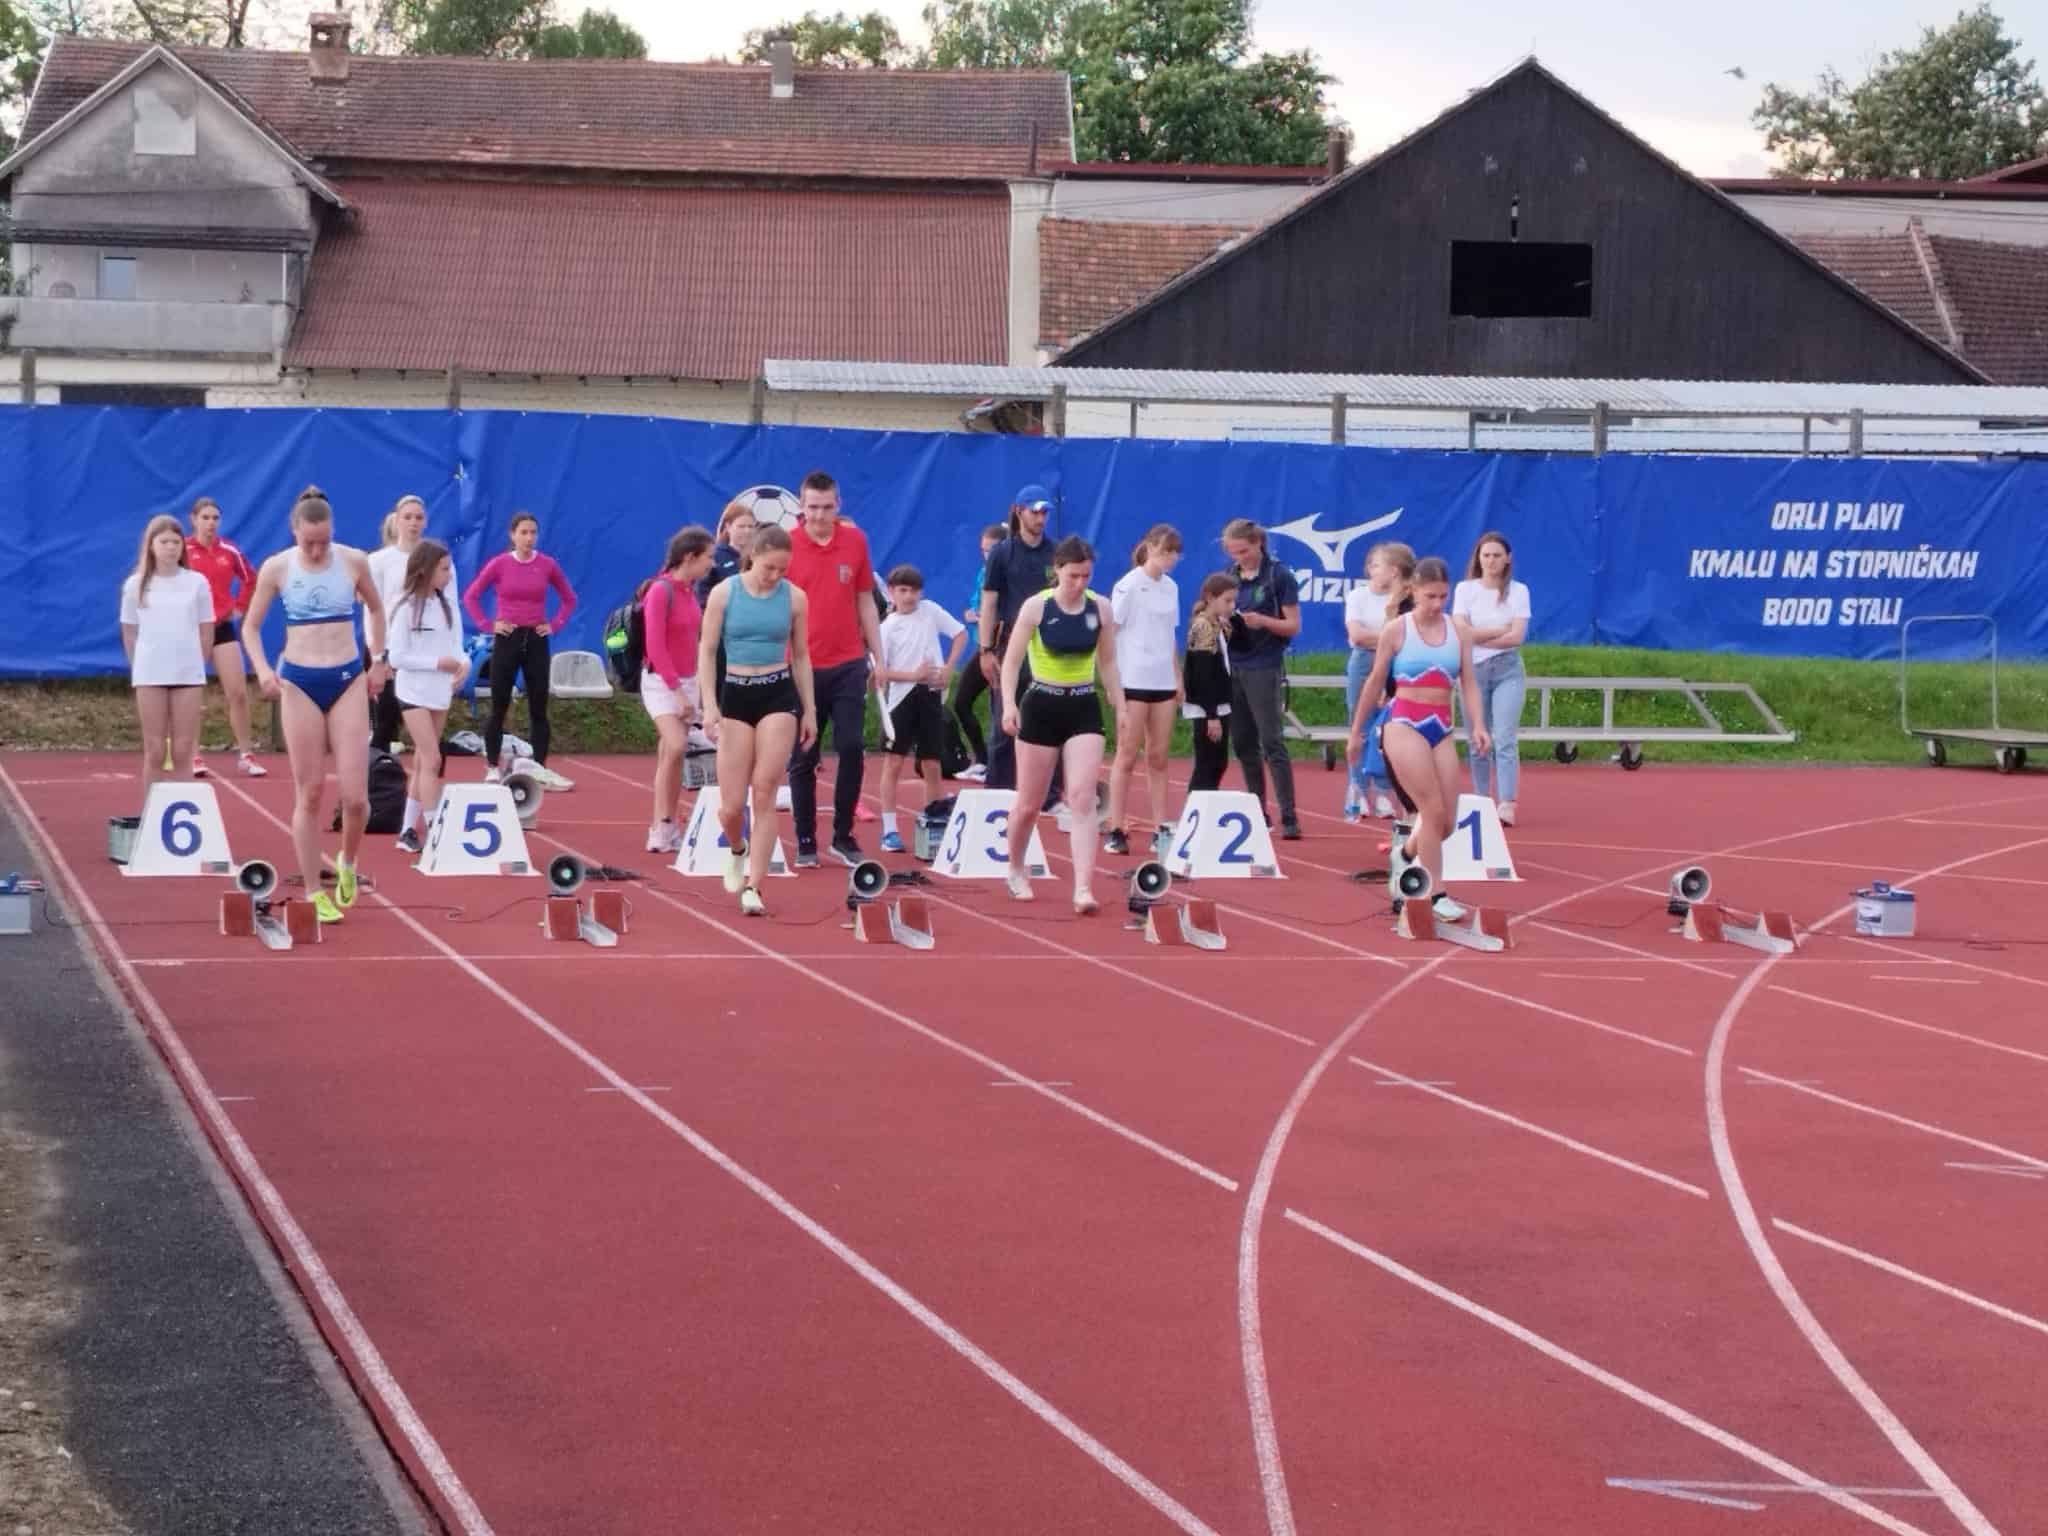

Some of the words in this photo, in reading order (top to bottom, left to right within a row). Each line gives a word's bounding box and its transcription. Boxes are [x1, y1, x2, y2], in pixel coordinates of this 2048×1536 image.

[1770, 501, 1829, 531] ORLI
[1833, 502, 1905, 531] PLAVI
[1688, 549, 1776, 578] KMALU
[1781, 550, 1818, 578] NA
[1824, 543, 1980, 579] STOPNIČKAH
[1762, 597, 1833, 626] BODO
[1838, 598, 1904, 626] STALI
[160, 800, 203, 857] 6
[462, 802, 502, 858] 5
[946, 811, 967, 863] 3
[1177, 808, 1199, 860] 2
[1217, 811, 1255, 863] 2
[1457, 809, 1483, 861] 1
